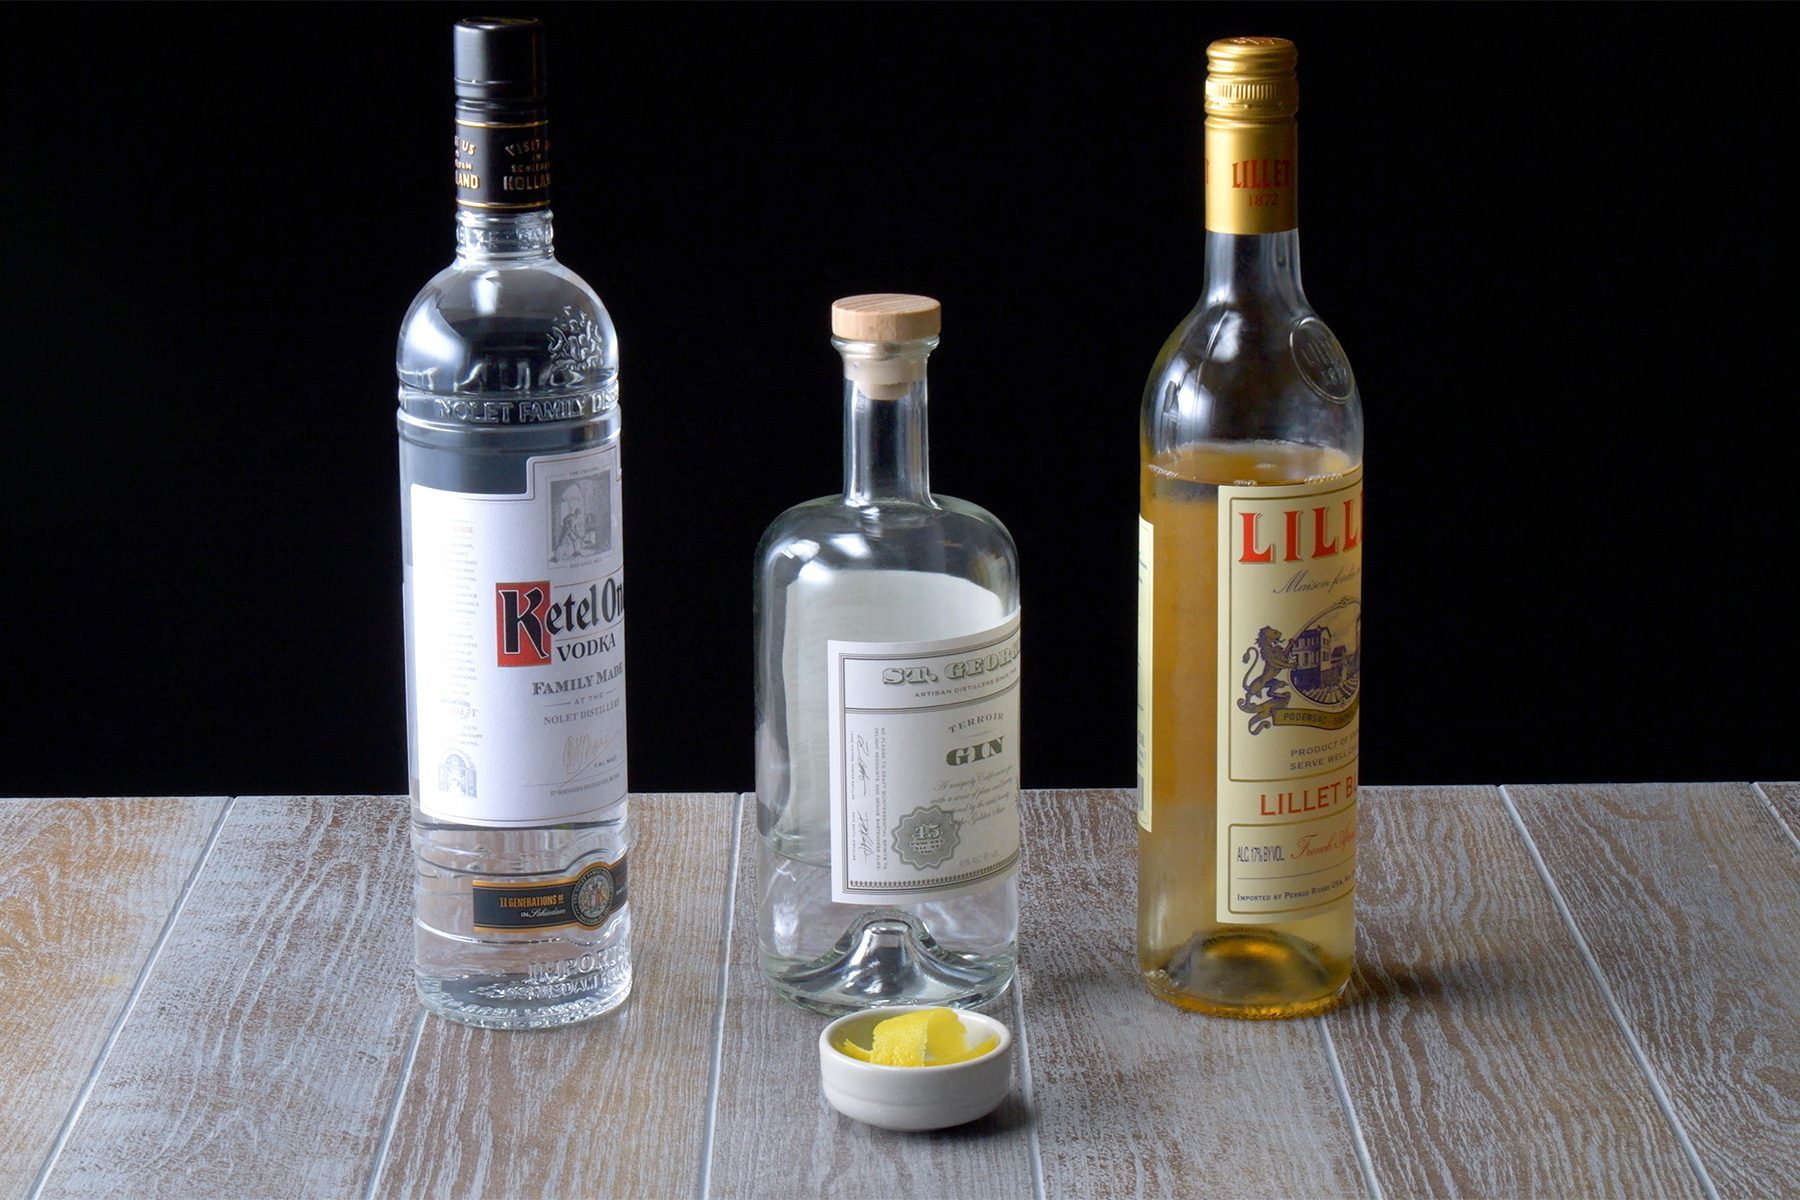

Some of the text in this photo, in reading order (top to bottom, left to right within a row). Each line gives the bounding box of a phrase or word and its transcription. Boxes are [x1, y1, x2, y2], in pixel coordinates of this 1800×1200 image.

[1232, 159, 1291, 189] LILLET
[1248, 193, 1279, 207] 1872
[435, 399, 514, 424] NOLET
[519, 397, 586, 423] FAMILY
[1239, 497, 1361, 563] LILL
[1273, 570, 1329, 593] Maison
[498, 584, 599, 659] Ketel
[556, 632, 616, 661] VODKA
[532, 661, 624, 695] FAMILY MADE
[883, 666, 938, 685] ST.
[574, 692, 604, 705] AT THE
[914, 689, 952, 698] ARTISAN
[954, 679, 994, 693] DISTILLERS
[543, 711, 578, 725] NOLET
[948, 712, 1004, 734] TERROIR
[946, 735, 1005, 766] GIN
[1290, 740, 1338, 757] PRODUCT
[1289, 759, 1324, 770] SERVE
[1328, 751, 1347, 763] WELL
[1260, 782, 1341, 816] LILLET
[1291, 832, 1337, 860] French
[508, 894, 557, 908] GENERATIONS
